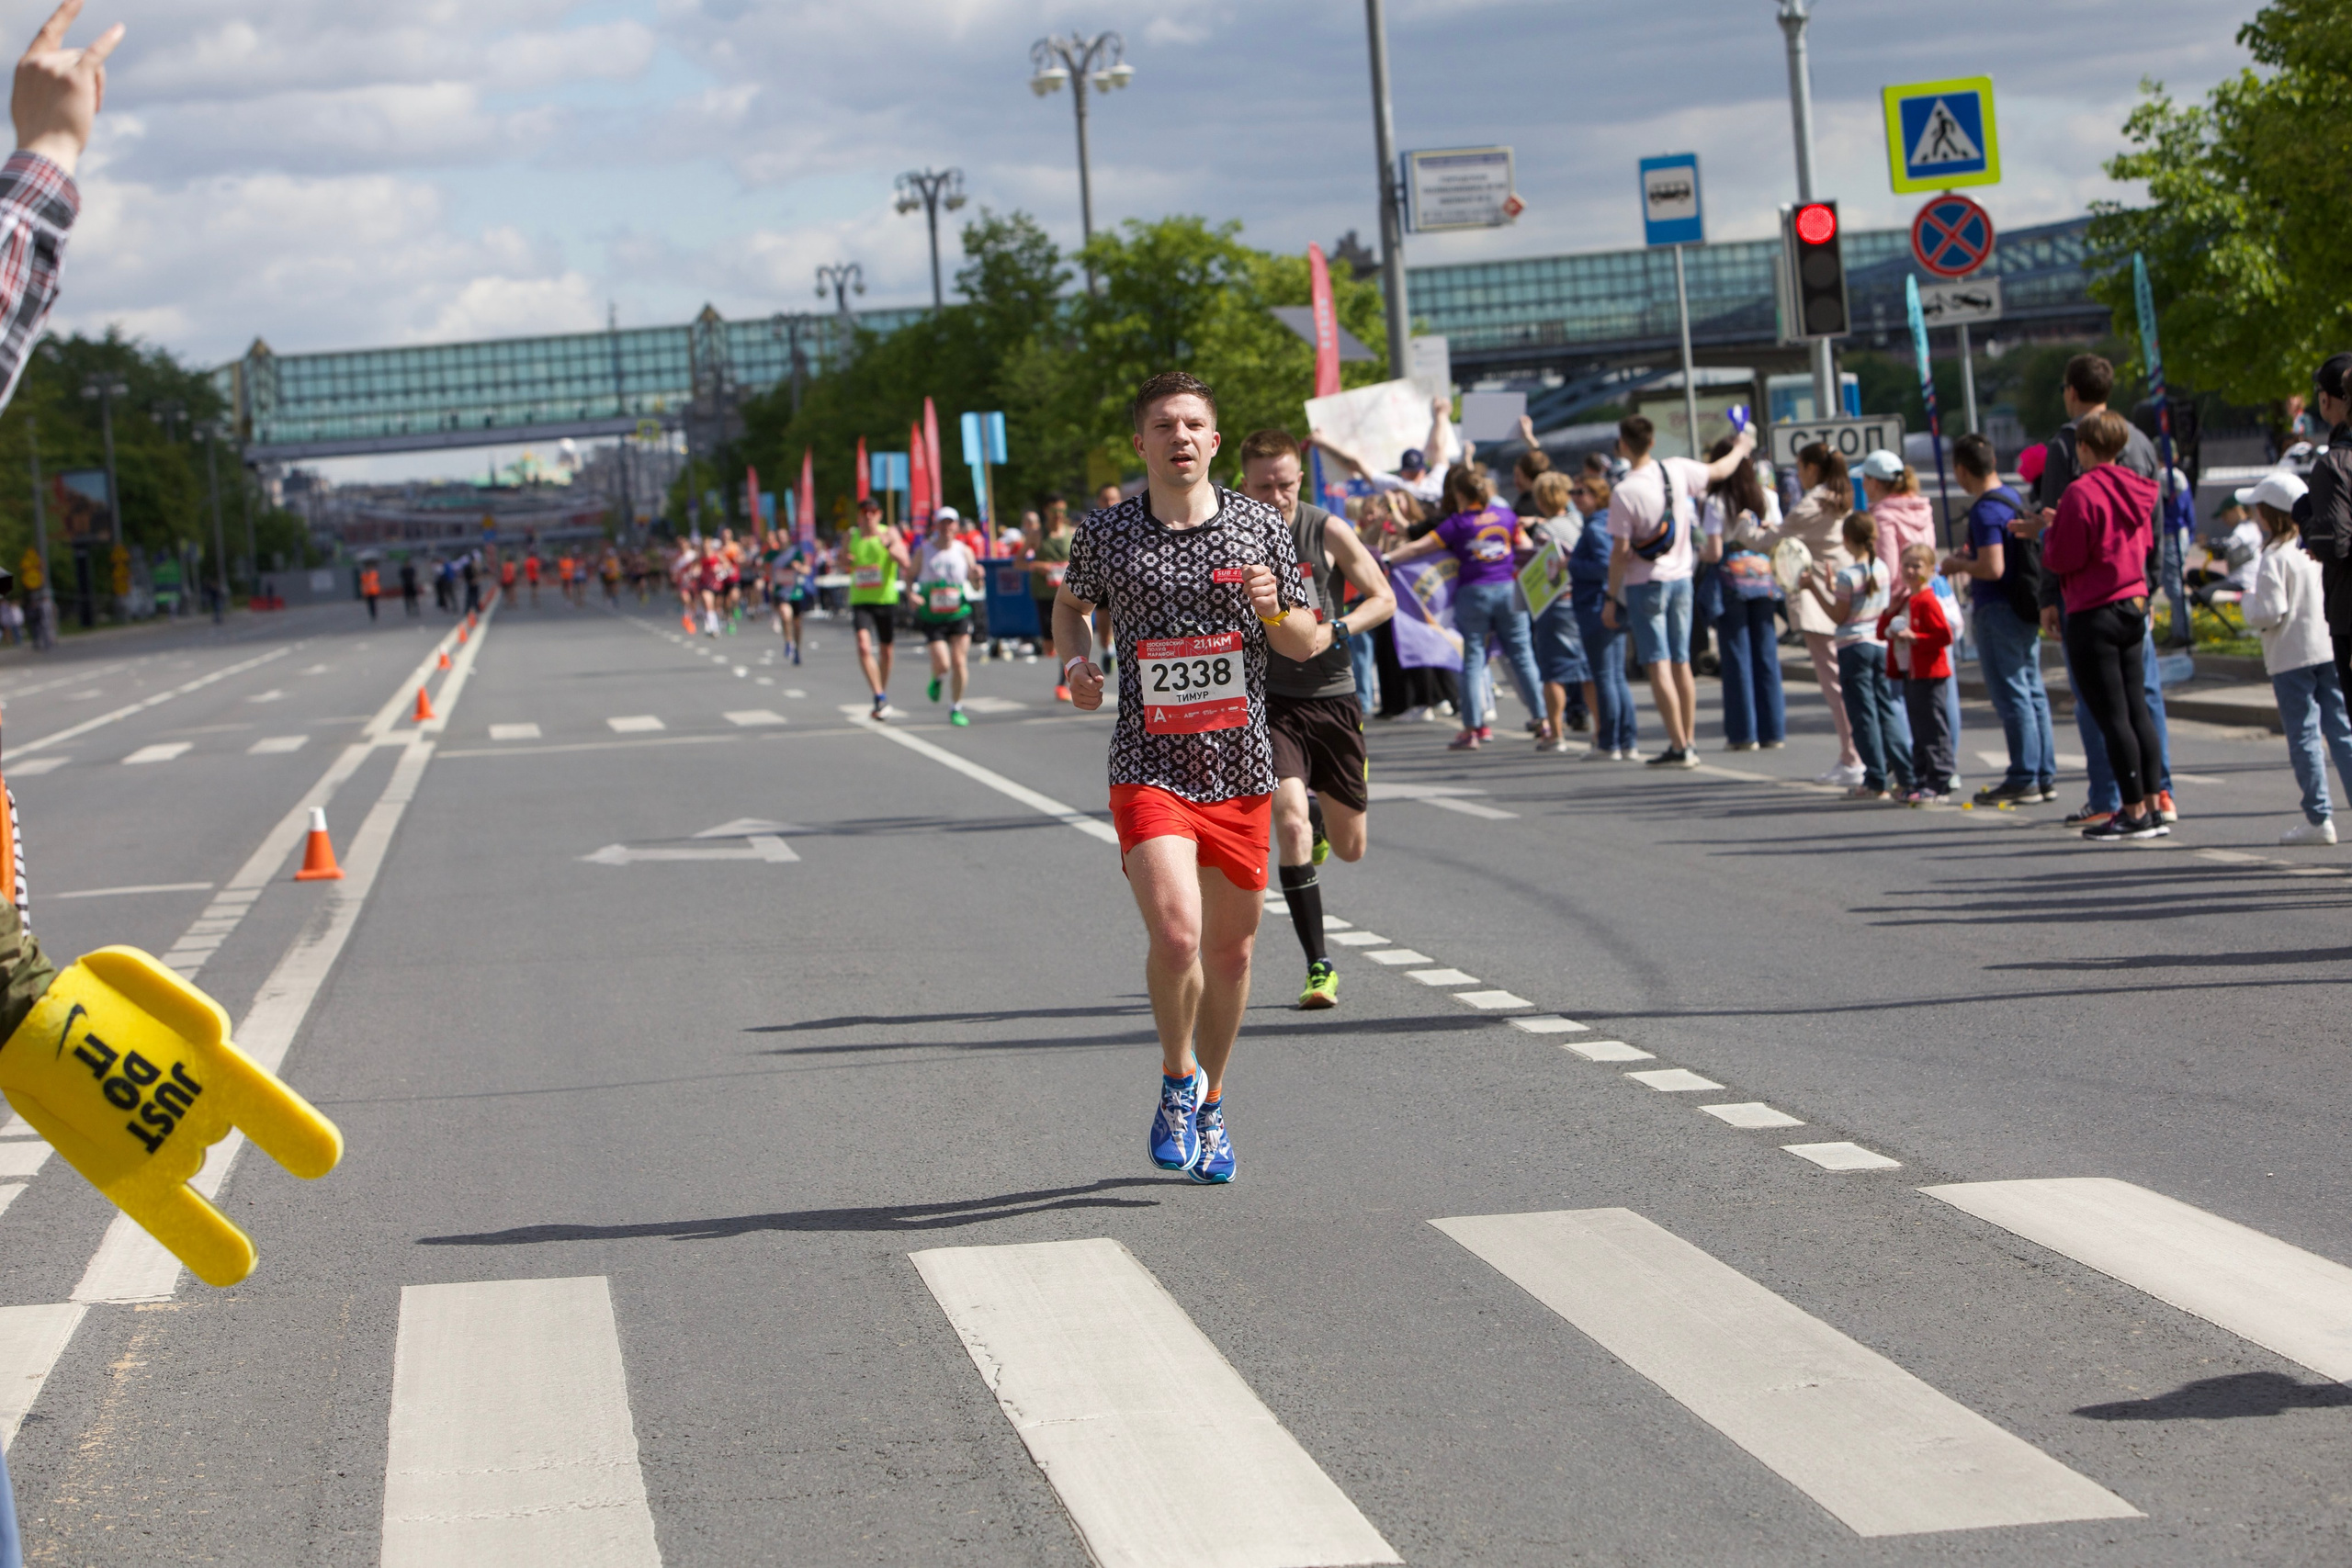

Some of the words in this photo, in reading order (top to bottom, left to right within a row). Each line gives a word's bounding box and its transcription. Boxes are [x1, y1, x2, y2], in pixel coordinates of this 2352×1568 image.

[1151, 658, 1231, 692] 2338
[1153, 706, 1167, 723] A
[1177, 691, 1209, 703] ТИМУР
[74, 1032, 119, 1080] IT
[103, 1049, 162, 1111] DO
[126, 1061, 203, 1155] JUST
